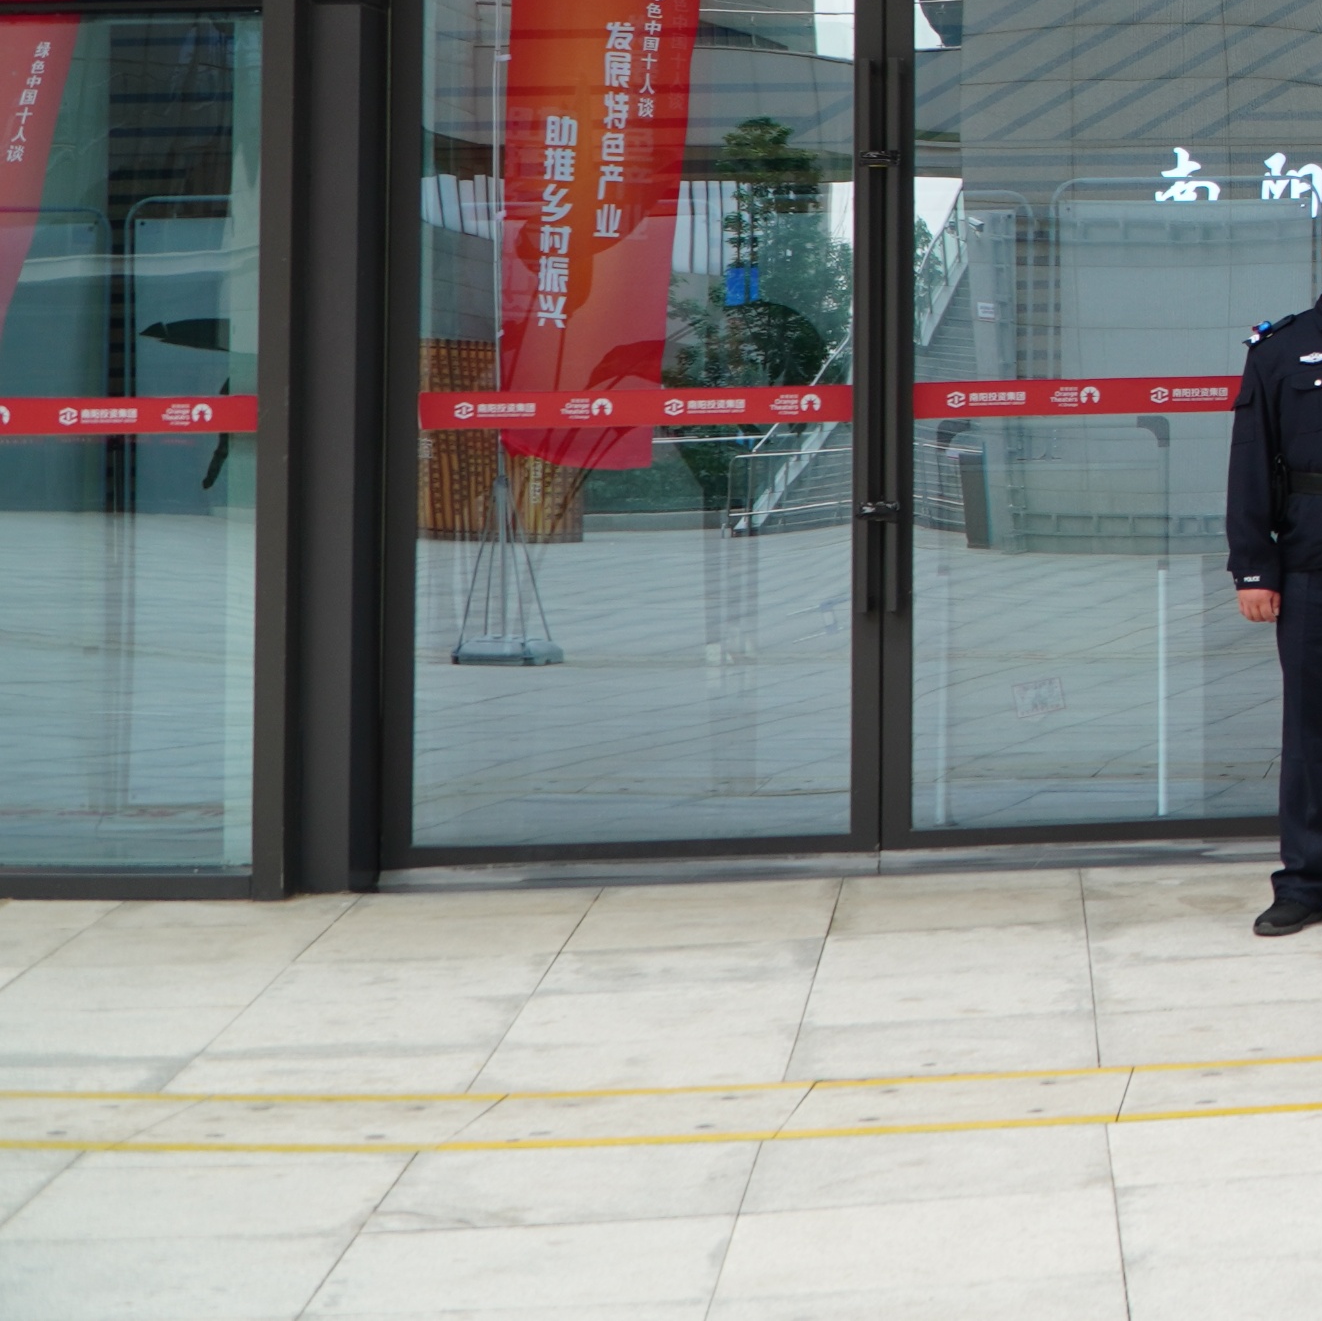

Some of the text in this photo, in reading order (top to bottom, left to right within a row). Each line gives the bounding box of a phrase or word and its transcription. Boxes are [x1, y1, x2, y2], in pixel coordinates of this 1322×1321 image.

[6, 41, 51, 163] 绿色中国十人谈
[593, 21, 635, 238] 发展特色产业
[537, 115, 578, 328] 助推乡村振兴
[969, 391, 1026, 402] 南阳投资集团
[1172, 387, 1228, 398] 南阳投资集团
